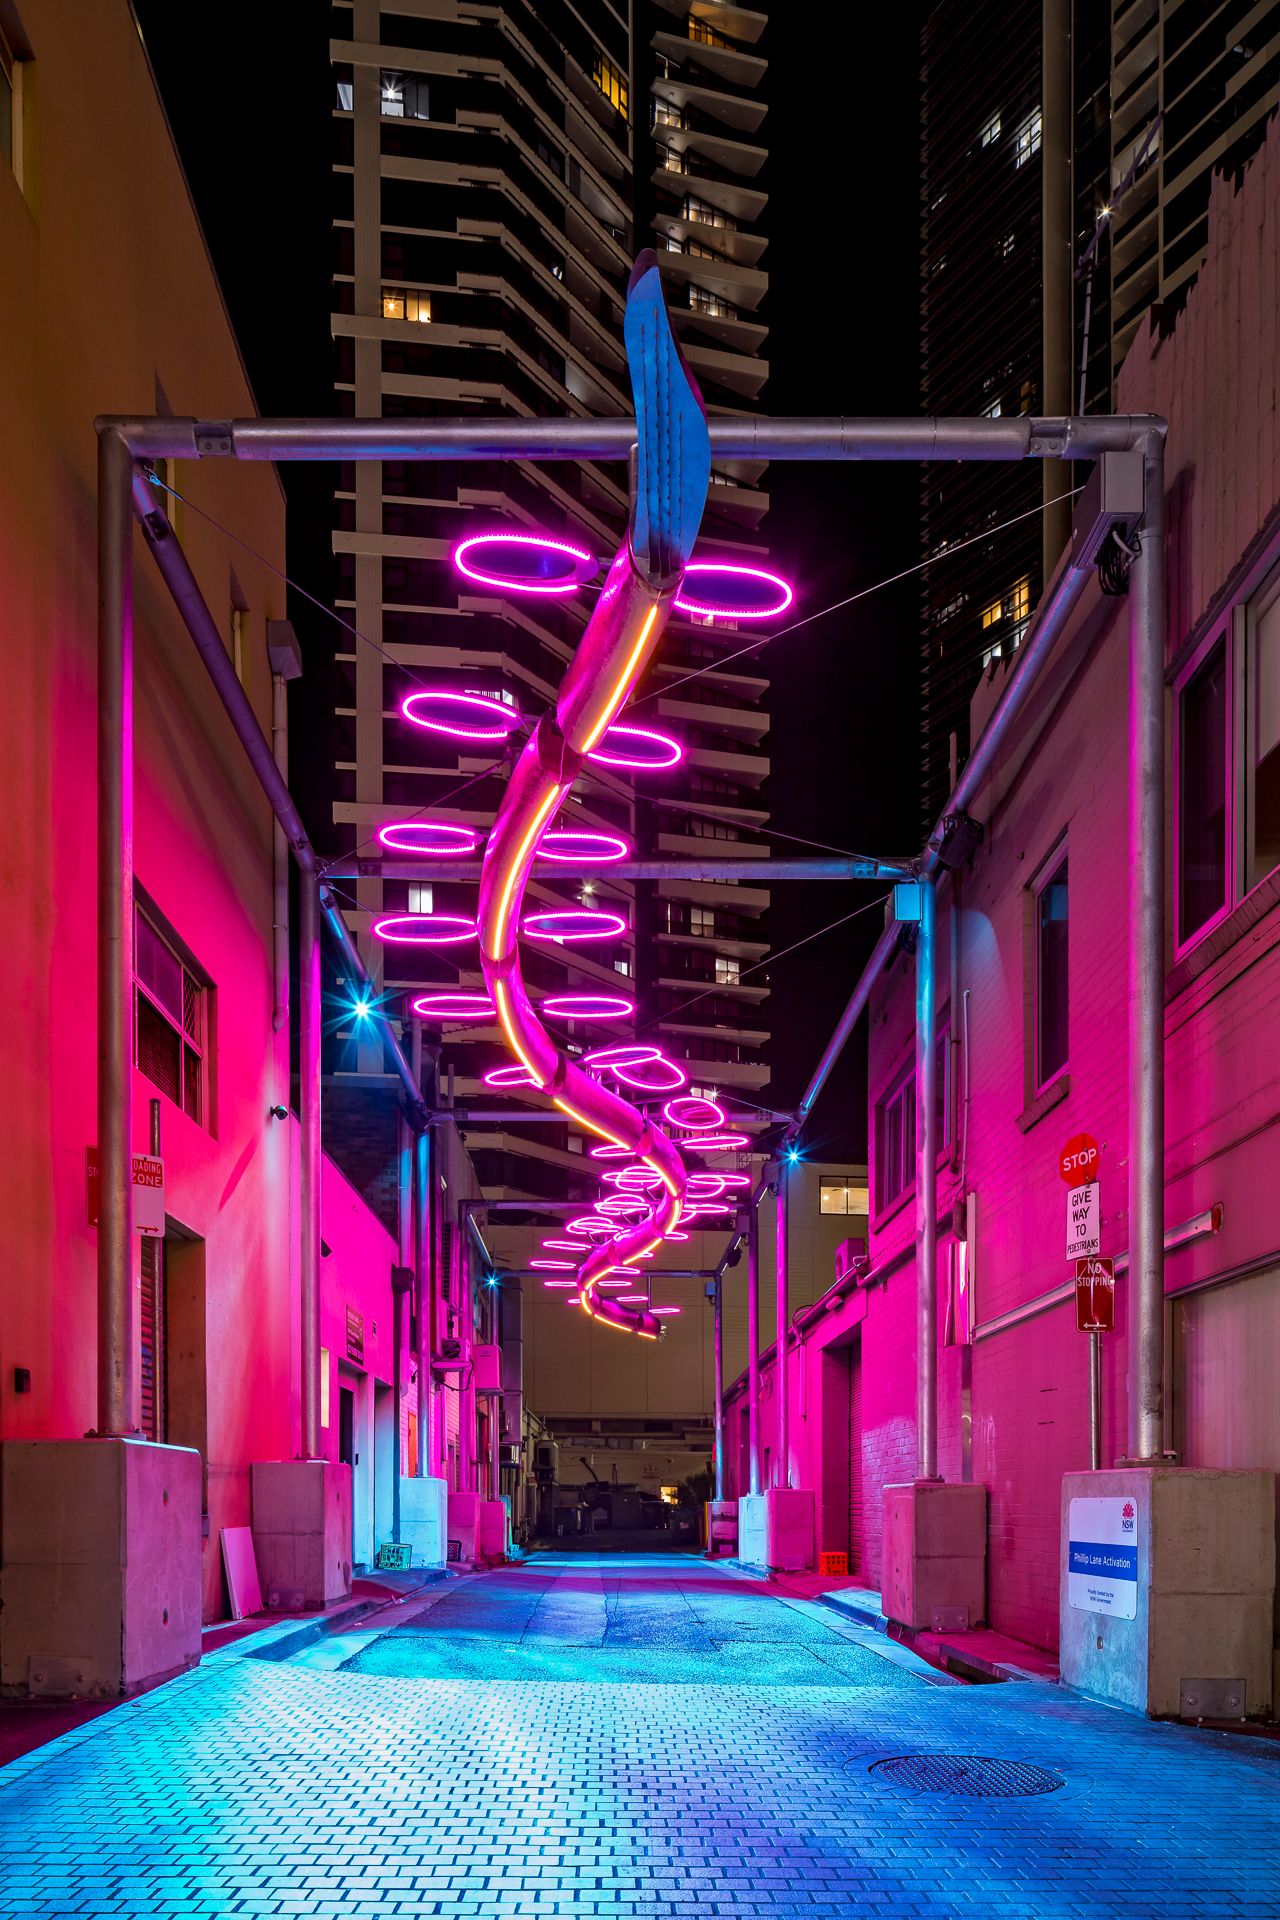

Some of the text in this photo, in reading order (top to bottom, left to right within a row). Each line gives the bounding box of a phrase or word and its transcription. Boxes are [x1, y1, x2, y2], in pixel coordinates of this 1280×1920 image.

[131, 1160, 161, 1174] OADING
[1063, 1148, 1097, 1172] STOP
[131, 1172, 162, 1187] ZONE
[1072, 1190, 1092, 1207] GIVE
[1072, 1206, 1090, 1222] WAY
[1075, 1223, 1087, 1238] TO
[1067, 1238, 1098, 1253] PEDESTRIANS
[1087, 1262, 1102, 1274] NO
[1122, 1520, 1134, 1530] NSW
[1089, 1555, 1102, 1566] Lane
[1103, 1556, 1131, 1568] Activation
